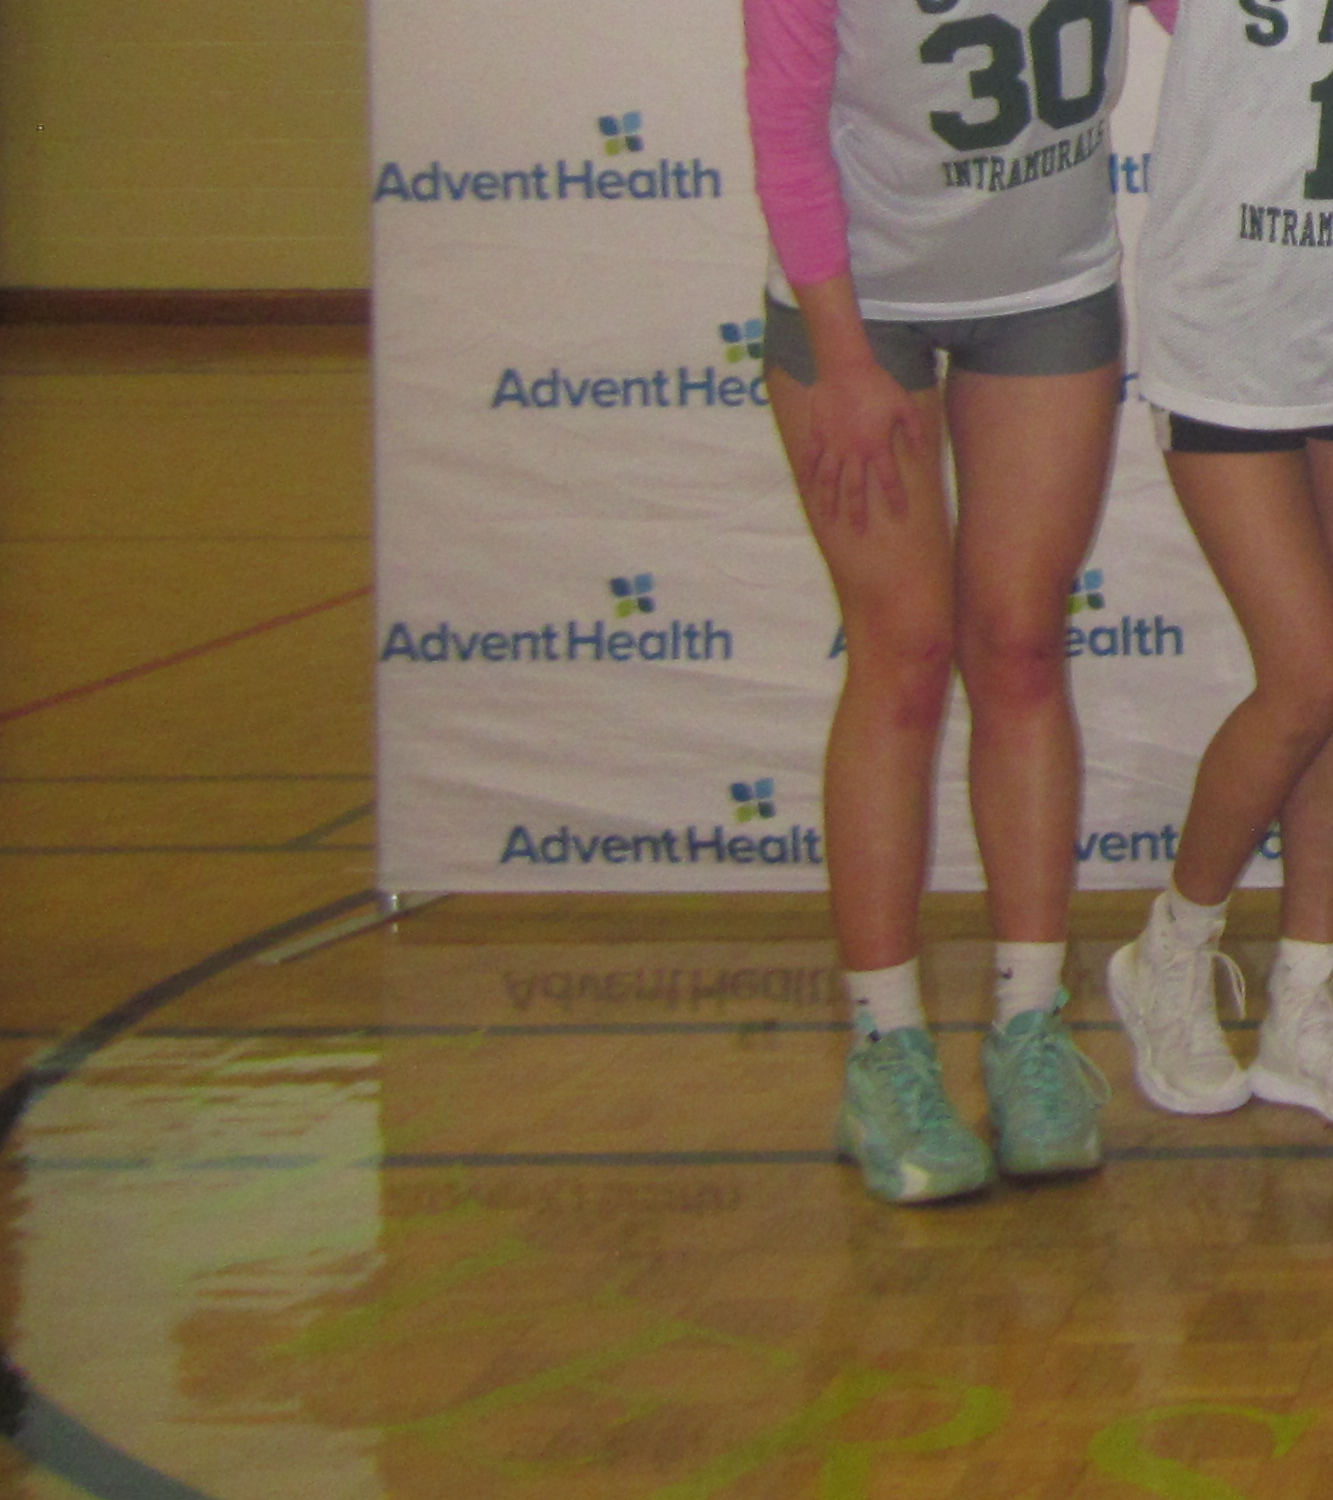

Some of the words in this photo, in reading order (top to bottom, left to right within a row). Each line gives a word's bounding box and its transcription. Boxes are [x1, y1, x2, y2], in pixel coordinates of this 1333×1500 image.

[372, 158, 721, 202] AdventHealth
[381, 621, 732, 662] AdventHealth
[500, 826, 822, 865] AdventHealt
